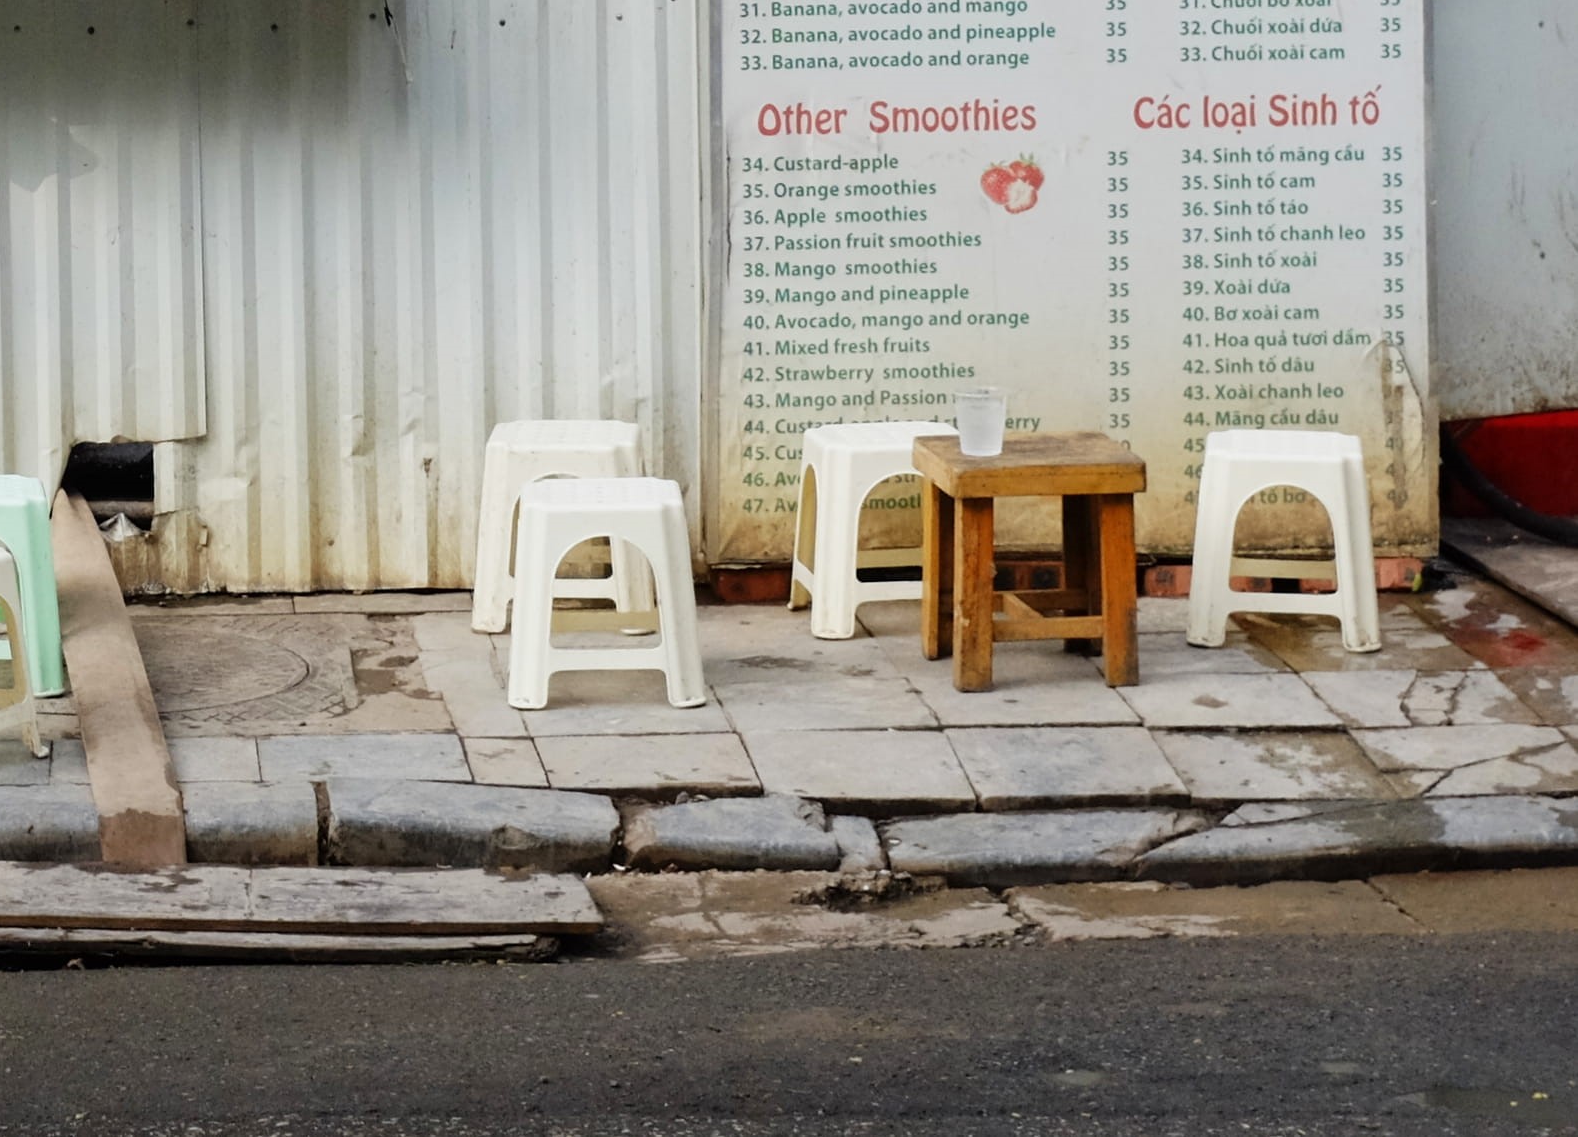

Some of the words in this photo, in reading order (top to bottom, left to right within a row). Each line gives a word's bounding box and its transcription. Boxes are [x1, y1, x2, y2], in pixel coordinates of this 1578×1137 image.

[1180, 21, 1206, 36] 32.
[1211, 19, 1262, 35] Chuối
[1268, 18, 1304, 34] xoài
[1310, 18, 1342, 33] dứa
[1381, 17, 1401, 32] 35
[758, 102, 847, 136] Other
[869, 99, 1036, 133] Smoothies
[1133, 95, 1190, 129] Các
[1203, 95, 1256, 134] loại
[1269, 94, 1337, 127] Sinh
[1349, 85, 1382, 126] tố
[742, 158, 769, 172] 34.
[774, 153, 898, 173] Custard-apple
[1108, 151, 1128, 166] 35
[744, 236, 769, 251] 37.
[775, 235, 841, 250] Passion
[846, 233, 884, 248] fruit
[890, 231, 982, 248] smoothies
[1108, 230, 1129, 245] 35
[1182, 228, 1208, 243] 37.
[1214, 226, 1252, 242] Sinh
[1257, 225, 1275, 241] tố
[1280, 225, 1333, 241] chanh
[1339, 224, 1365, 240] leo
[1383, 226, 1403, 240] 35
[1183, 281, 1209, 295] 39.
[1215, 279, 1252, 295] Xoài
[1258, 279, 1290, 294] dứa
[1384, 278, 1404, 293] 35
[743, 315, 769, 329] 40.
[775, 312, 856, 329] Avocado,
[862, 315, 923, 330] mango
[929, 310, 961, 326] and
[967, 313, 1029, 329] orange
[1110, 309, 1129, 323] 35
[743, 342, 770, 356] 41.
[775, 339, 828, 355] Mixed
[834, 338, 878, 354] fresh
[884, 337, 930, 353] fruits
[1110, 335, 1129, 350] 35
[742, 367, 769, 382] 42.
[775, 365, 874, 383] Strawberry
[883, 363, 975, 379] smoothies
[1110, 361, 1130, 376] 35
[1183, 385, 1209, 401] 43.
[1215, 385, 1253, 399] Xoài
[1258, 383, 1312, 399] chanh
[1318, 383, 1344, 398] leo
